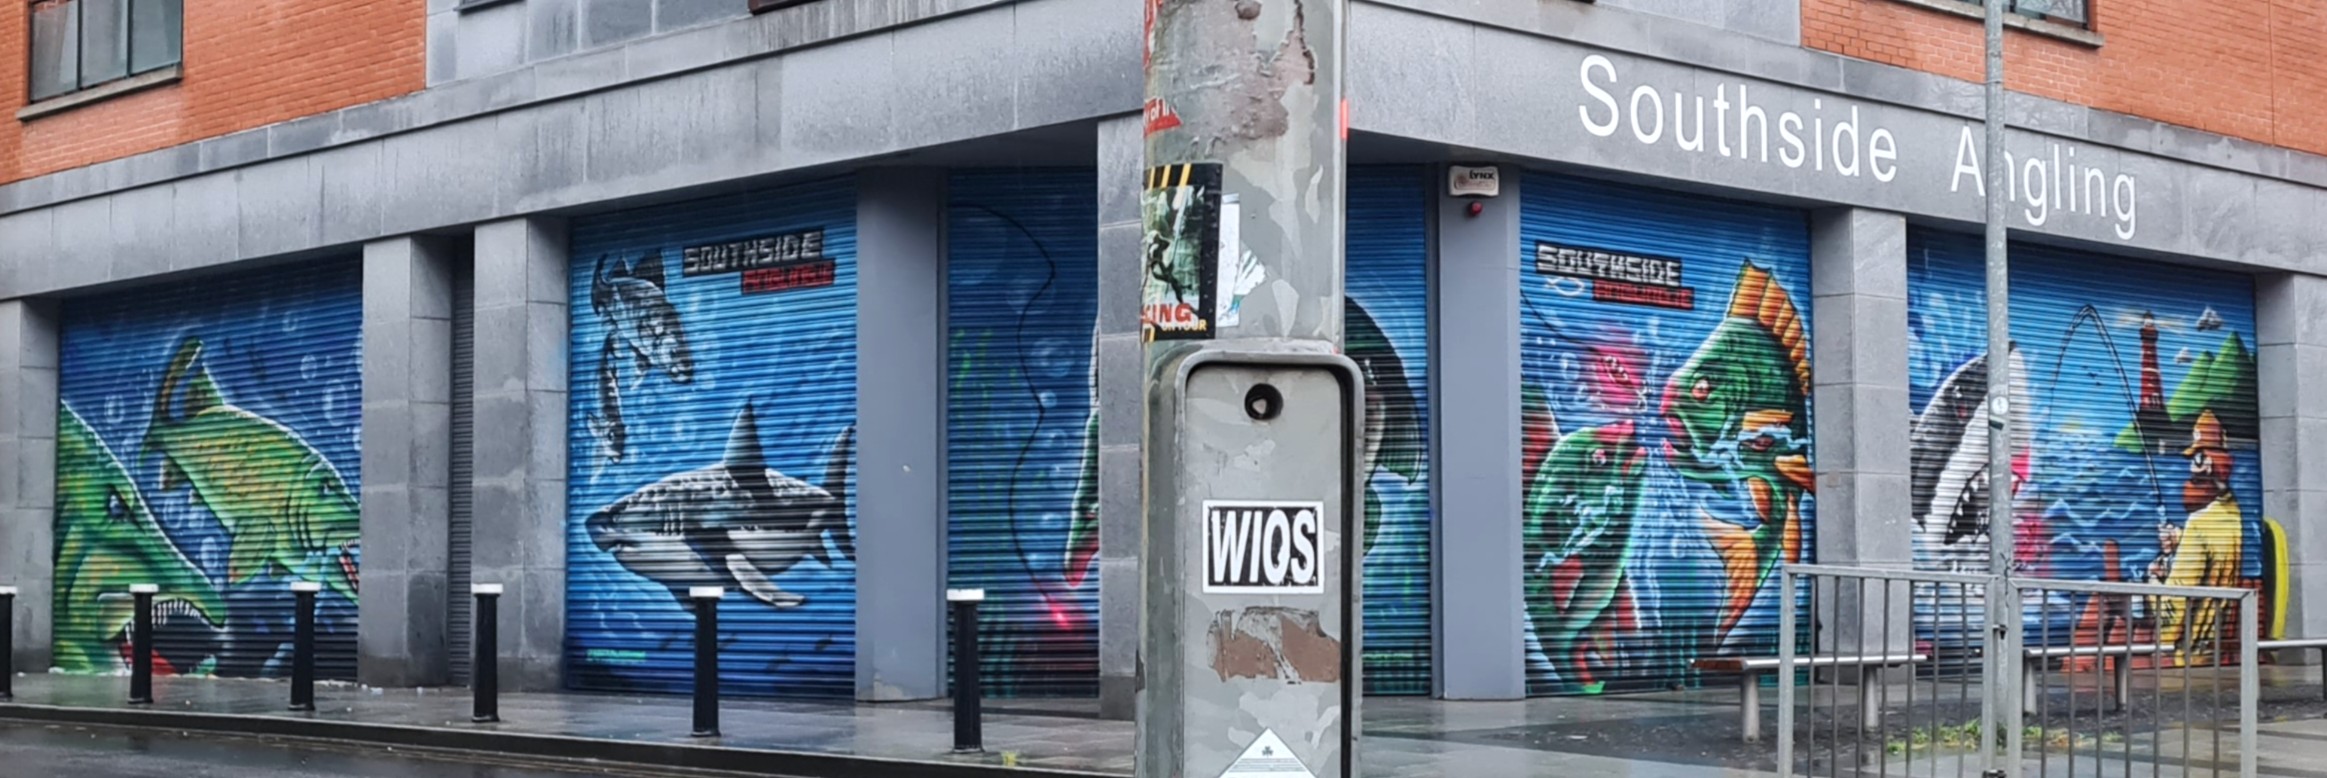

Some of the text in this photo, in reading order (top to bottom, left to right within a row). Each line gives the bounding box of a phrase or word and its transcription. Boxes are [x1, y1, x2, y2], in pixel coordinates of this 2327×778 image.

[1578, 54, 1898, 182] Southside
[684, 231, 822, 274] SOUTHSIDE
[1537, 244, 1681, 287] SOUTHSIDE
